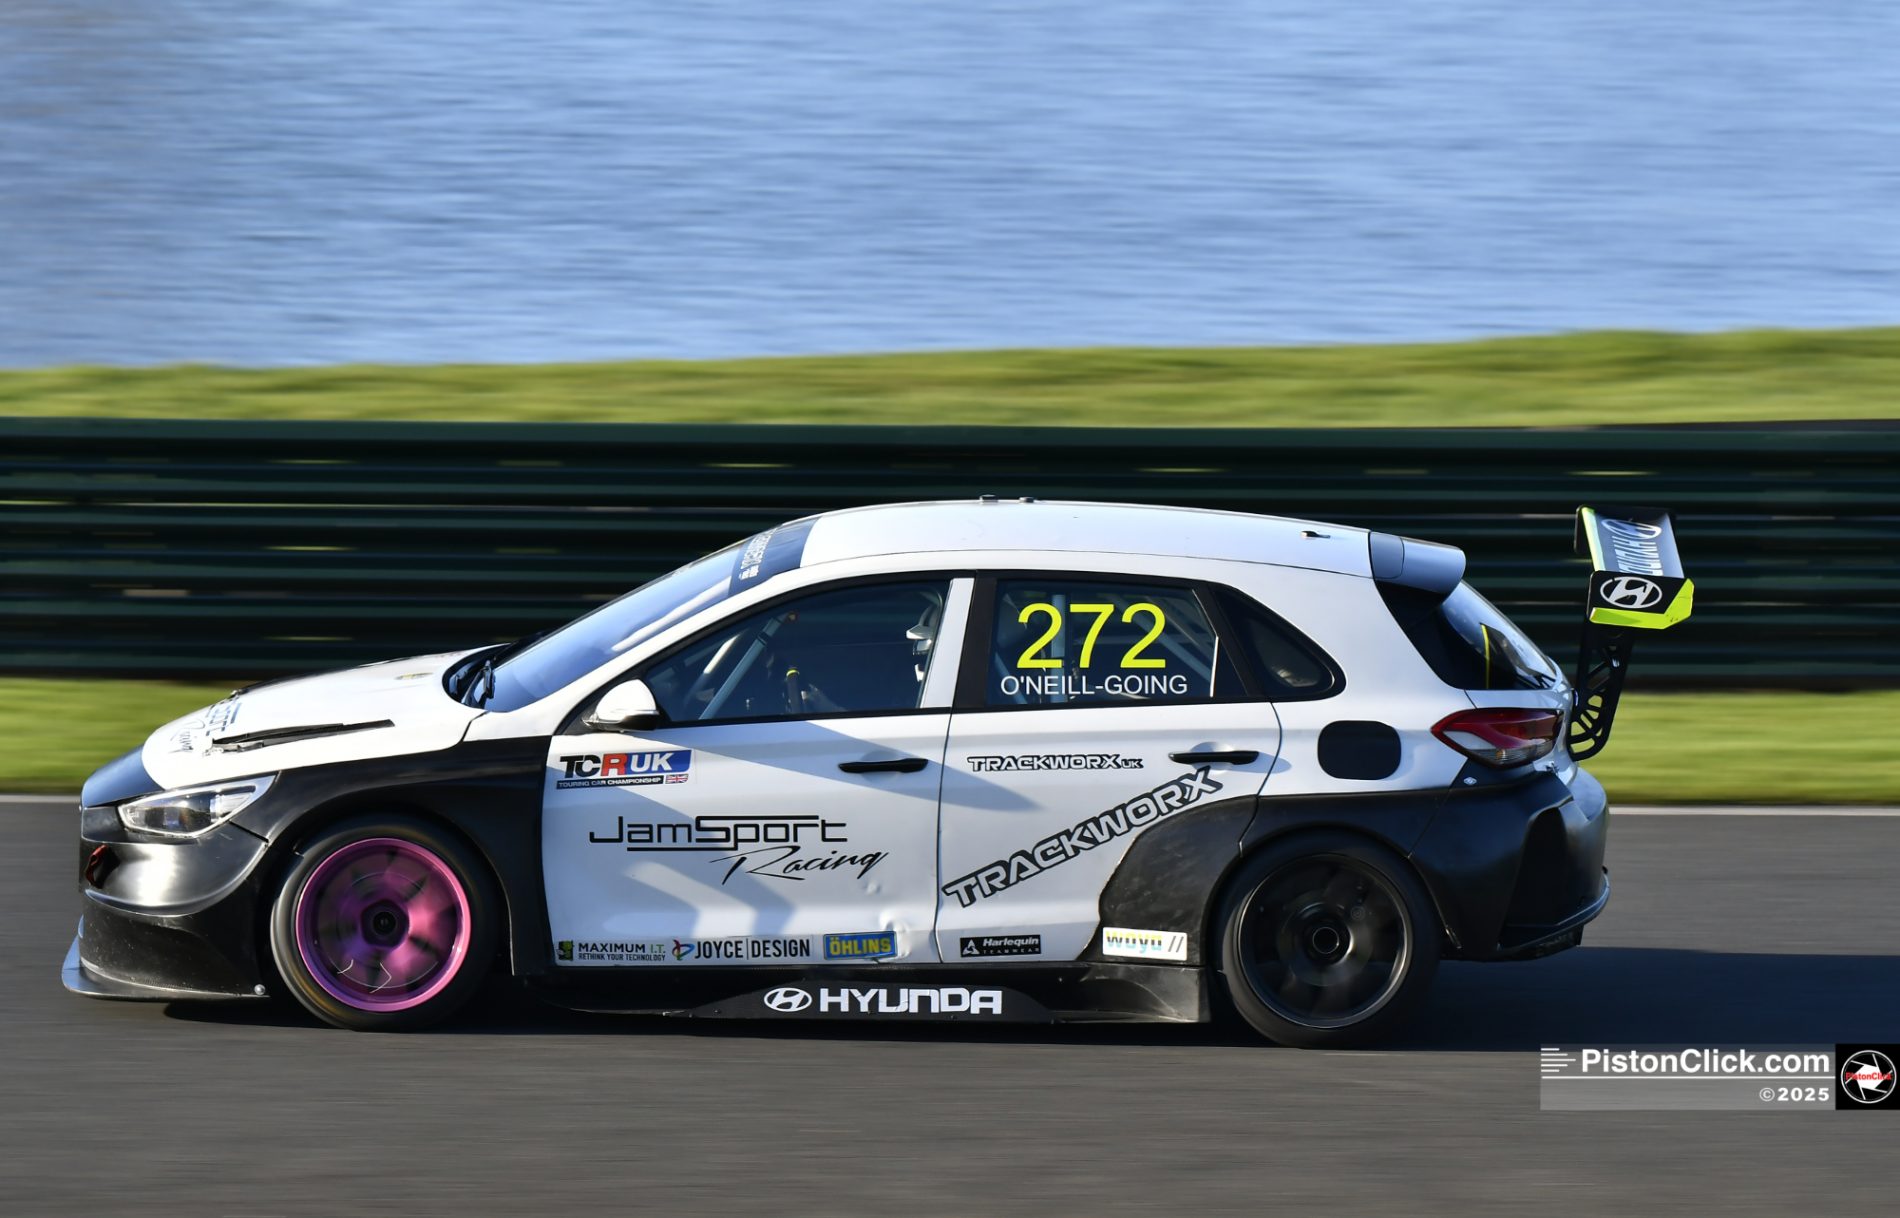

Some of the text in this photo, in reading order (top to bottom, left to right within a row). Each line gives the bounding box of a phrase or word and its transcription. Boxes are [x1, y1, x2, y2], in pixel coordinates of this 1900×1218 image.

[1017, 602, 1166, 668] 272
[1000, 675, 1188, 695] O'NEILL-GOING
[559, 752, 674, 778] TCR UK
[967, 754, 1143, 771] TRACKWORX UK
[607, 777, 662, 785] CHAMPIONSHIP
[589, 815, 848, 851] JamSport
[942, 765, 1223, 908] TRACKWORX
[709, 845, 889, 885] Racing
[578, 943, 666, 954] MAXIMUM I.T.
[694, 939, 810, 959] JOYCE DESIGN
[829, 936, 891, 956] ÖHLINS
[982, 936, 1039, 947] Harlequin
[982, 947, 1039, 955] TEAMWEAR
[578, 952, 666, 961] RETHINK YOUR TECHNOLOGY
